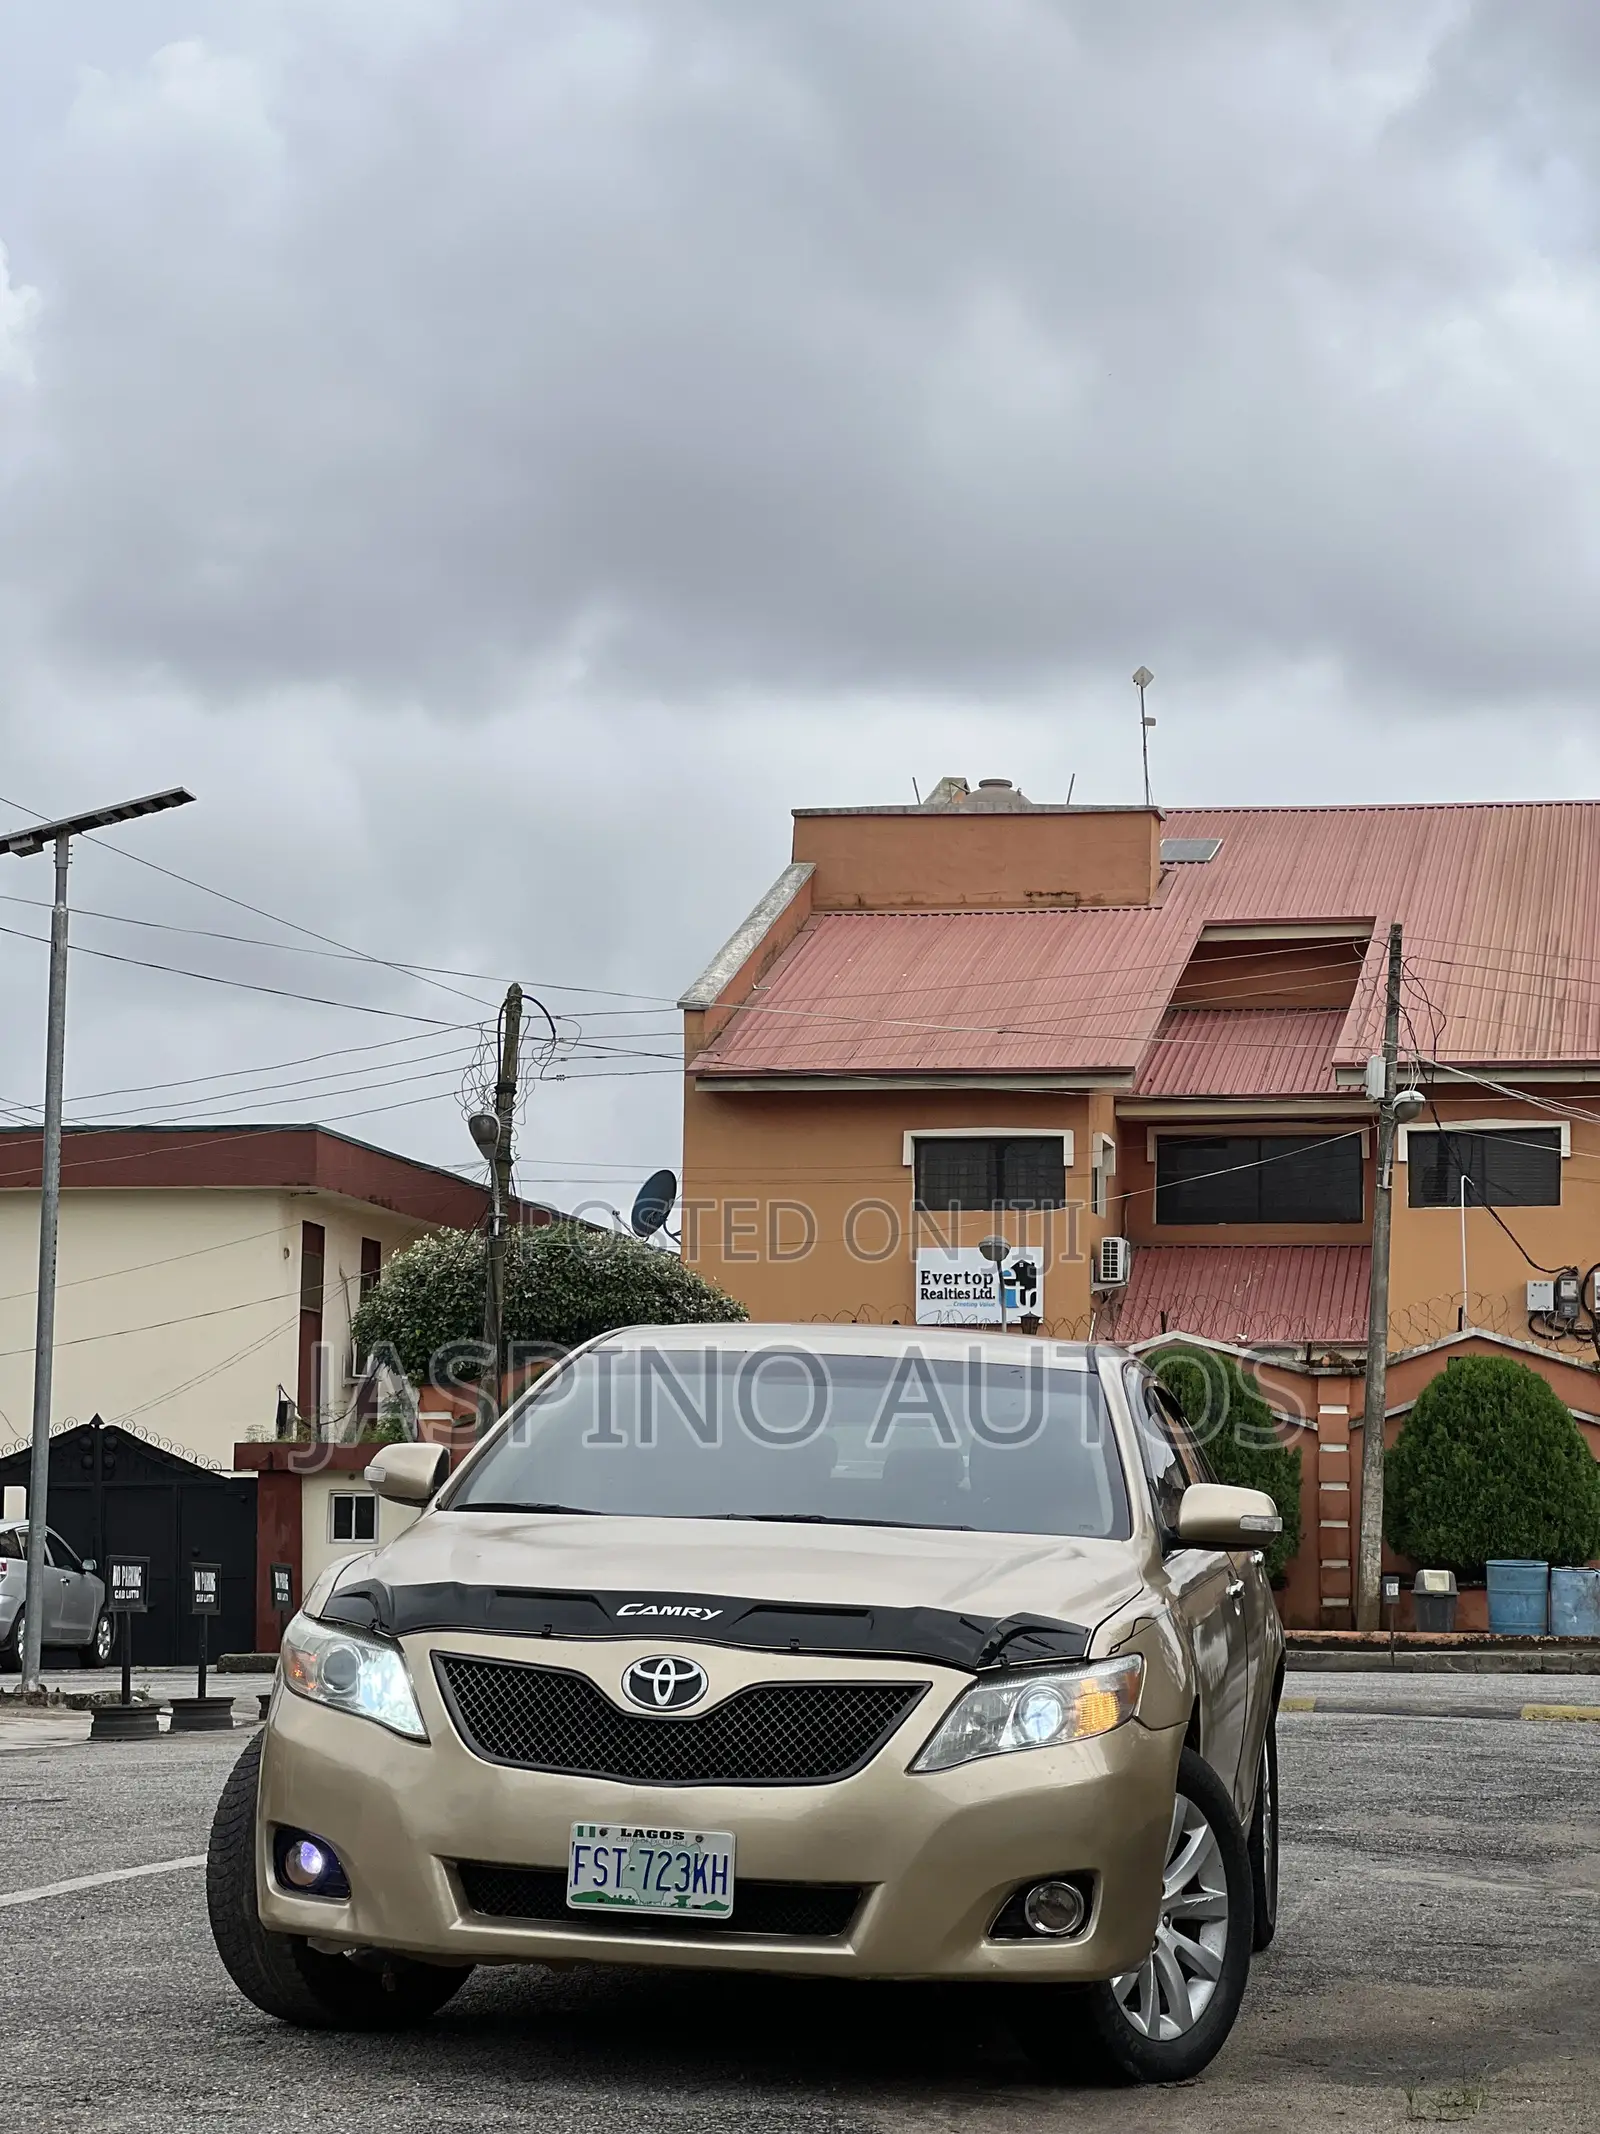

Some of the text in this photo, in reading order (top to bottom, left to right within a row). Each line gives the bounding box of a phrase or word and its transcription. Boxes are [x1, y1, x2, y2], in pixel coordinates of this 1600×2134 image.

[920, 1270, 994, 1289] Evertop
[920, 1287, 996, 1300] Realties Ltd.
[112, 1564, 121, 1587] NO
[616, 1603, 723, 1620] CAMRY
[620, 1828, 686, 1841] LAGOS
